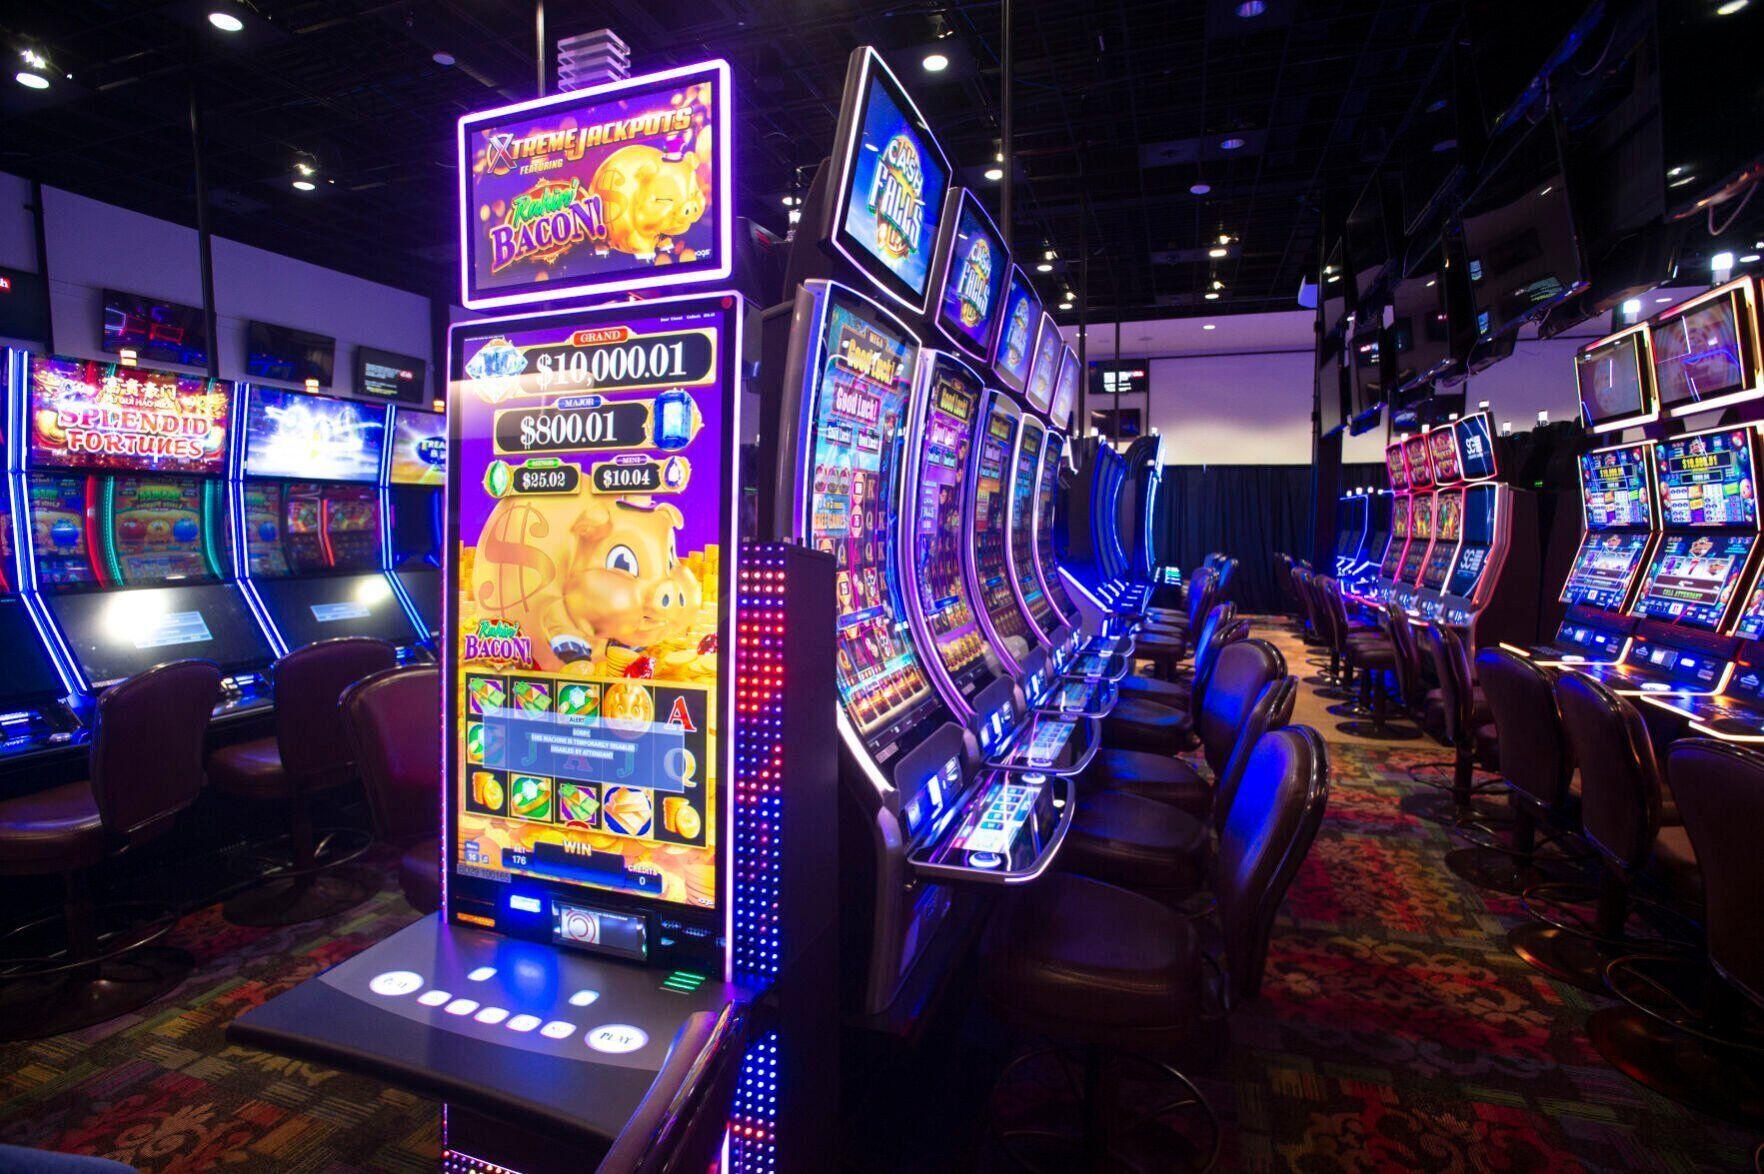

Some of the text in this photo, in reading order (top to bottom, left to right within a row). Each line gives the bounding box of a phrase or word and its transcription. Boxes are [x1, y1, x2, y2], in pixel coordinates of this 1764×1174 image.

[566, 107, 692, 161] JACKPOTS
[520, 158, 563, 175] FEATURING
[888, 139, 923, 196] CASH
[869, 160, 923, 249] FALLS
[491, 197, 607, 270] BACON!
[579, 330, 621, 343] GRAND
[536, 341, 687, 387] $10,000.01
[847, 339, 873, 374] Good
[564, 397, 595, 408] MAJOR
[58, 404, 212, 437] SPLENDID
[520, 411, 618, 449] $800.01
[66, 428, 205, 460] FORTUNES
[622, 456, 641, 464] MINI
[522, 471, 565, 490] $25.02
[603, 469, 650, 488] $10.04
[465, 634, 533, 665] BACON!
[663, 695, 697, 732] A
[663, 747, 698, 788] Q
[512, 855, 527, 865] 176
[563, 840, 593, 857] WIN
[627, 864, 659, 876] CREDITS
[639, 876, 646, 886] 0
[600, 1031, 632, 1045] PLAY
